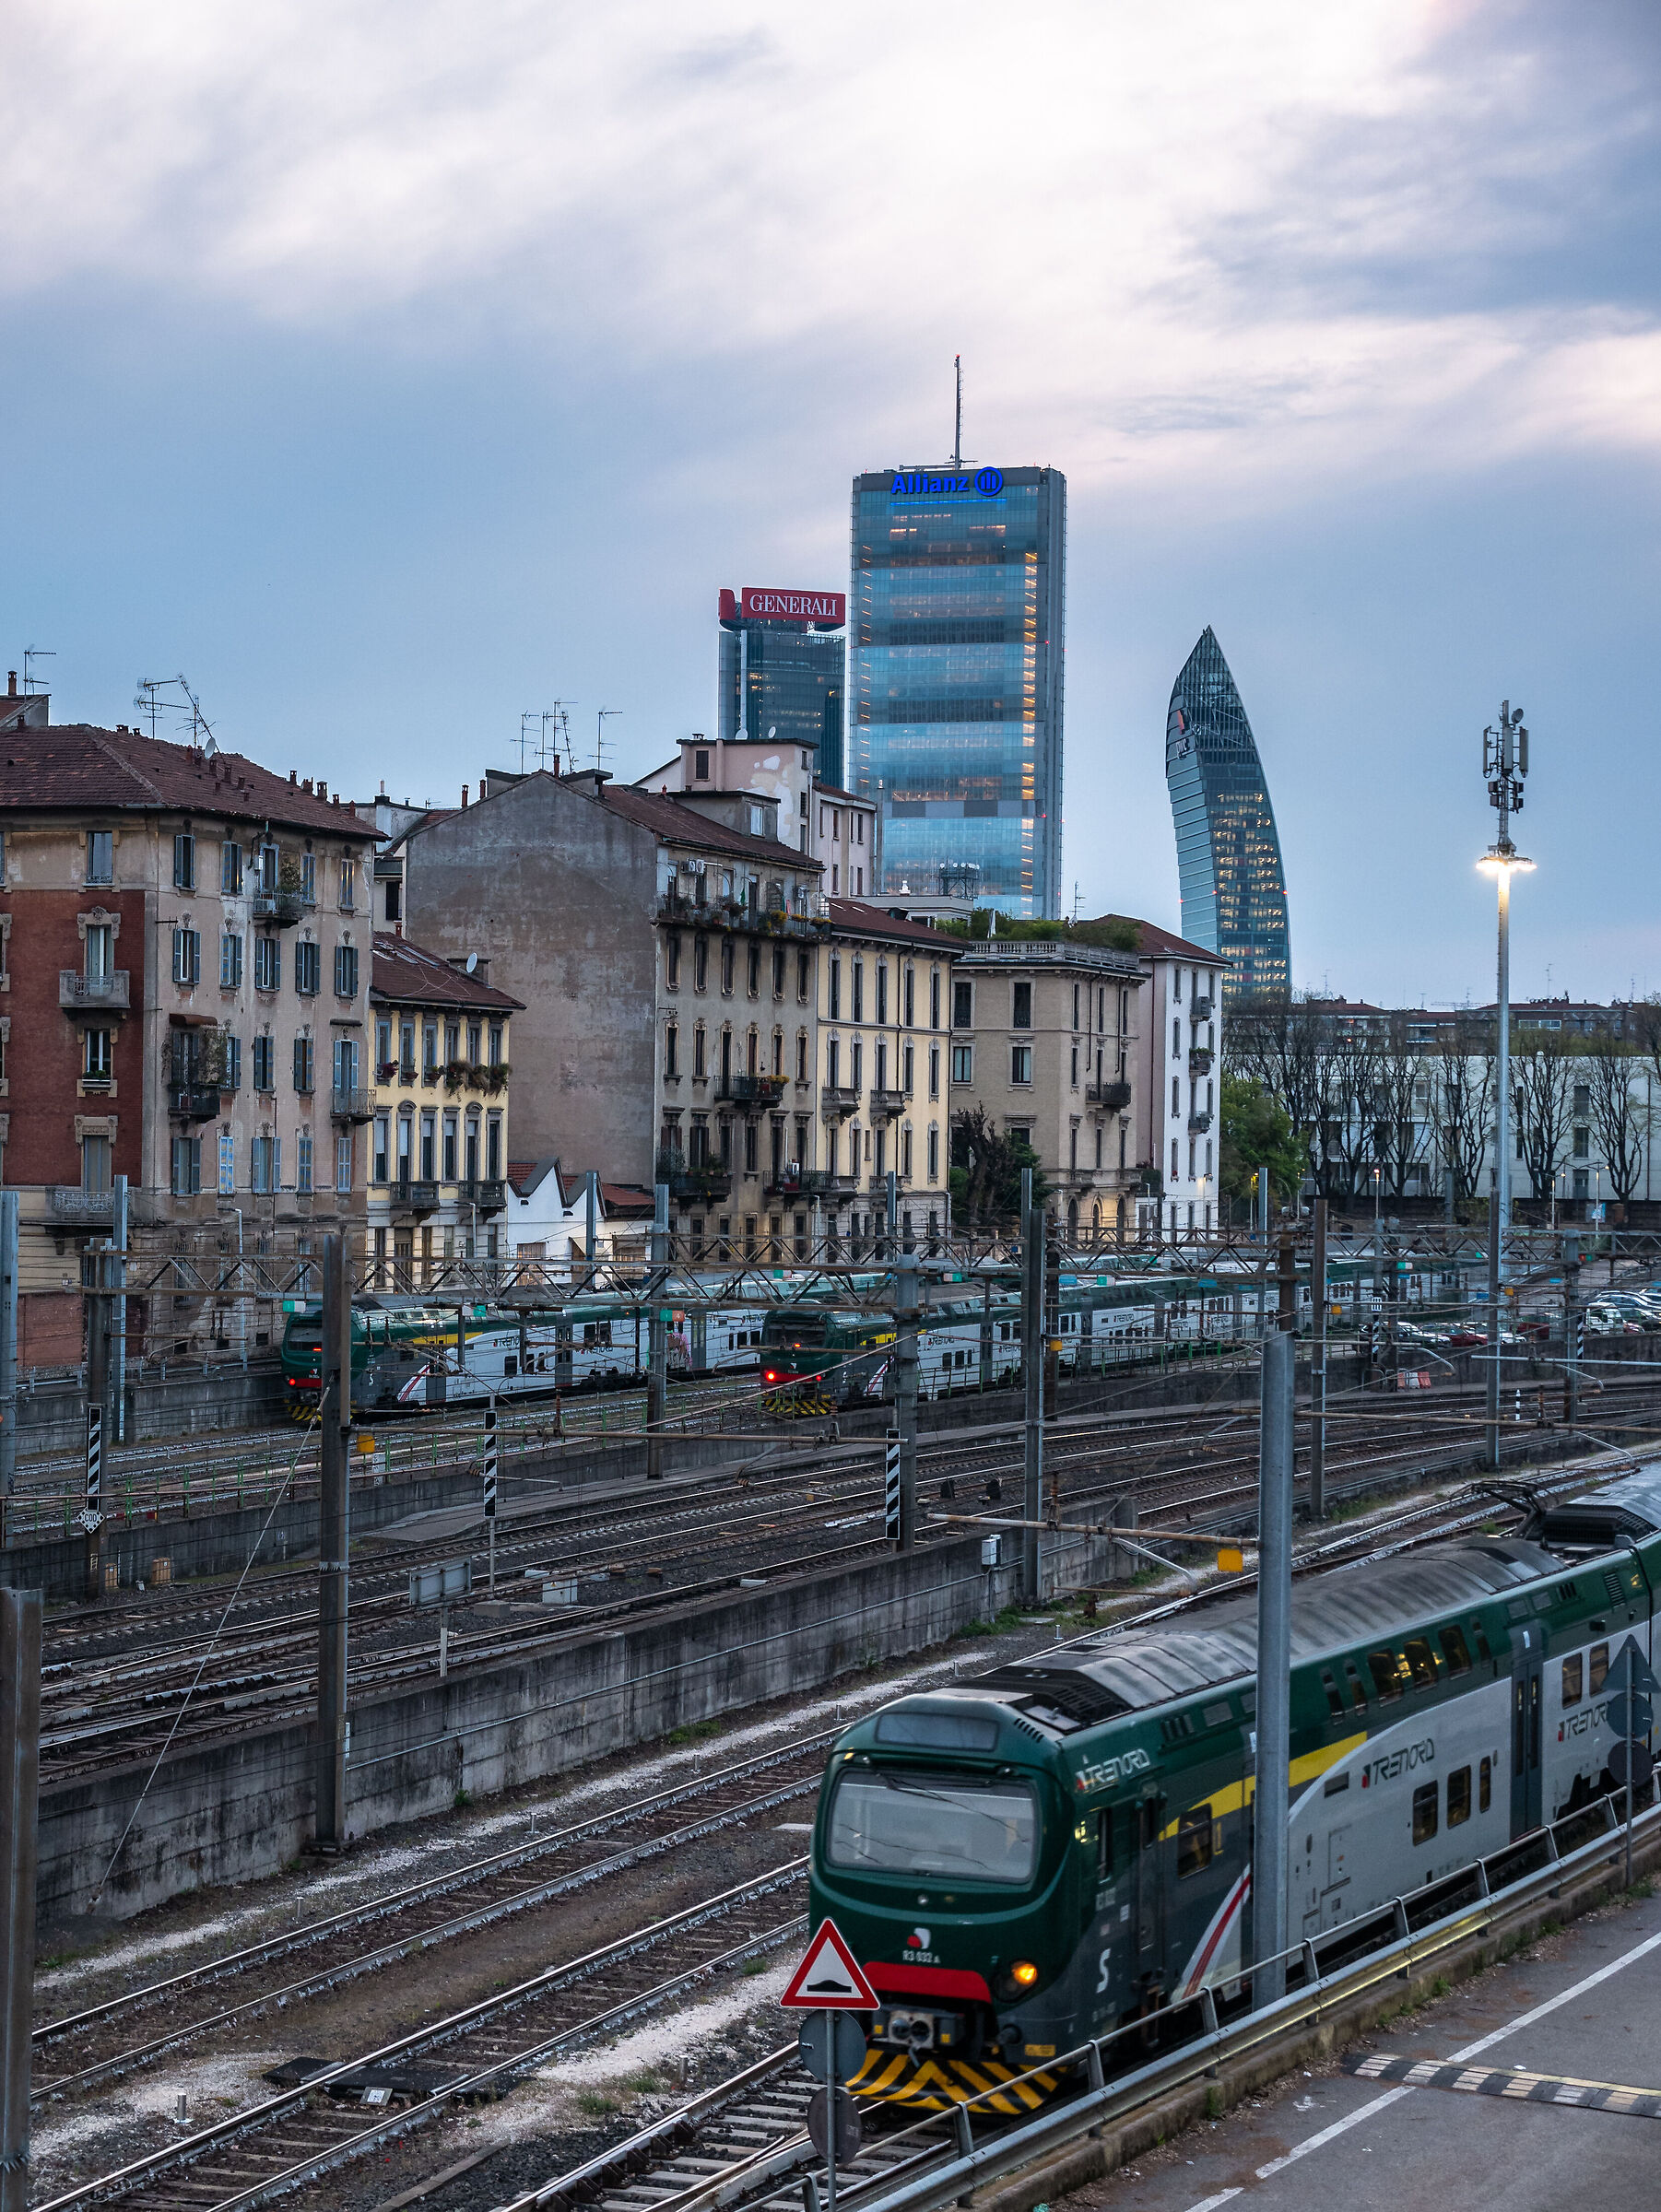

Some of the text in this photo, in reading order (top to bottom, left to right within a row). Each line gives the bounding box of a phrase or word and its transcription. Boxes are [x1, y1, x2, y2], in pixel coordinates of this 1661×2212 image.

[891, 474, 970, 495] Allianz
[749, 594, 837, 617] GENERALI
[1566, 1700, 1611, 1740] TRENOR
